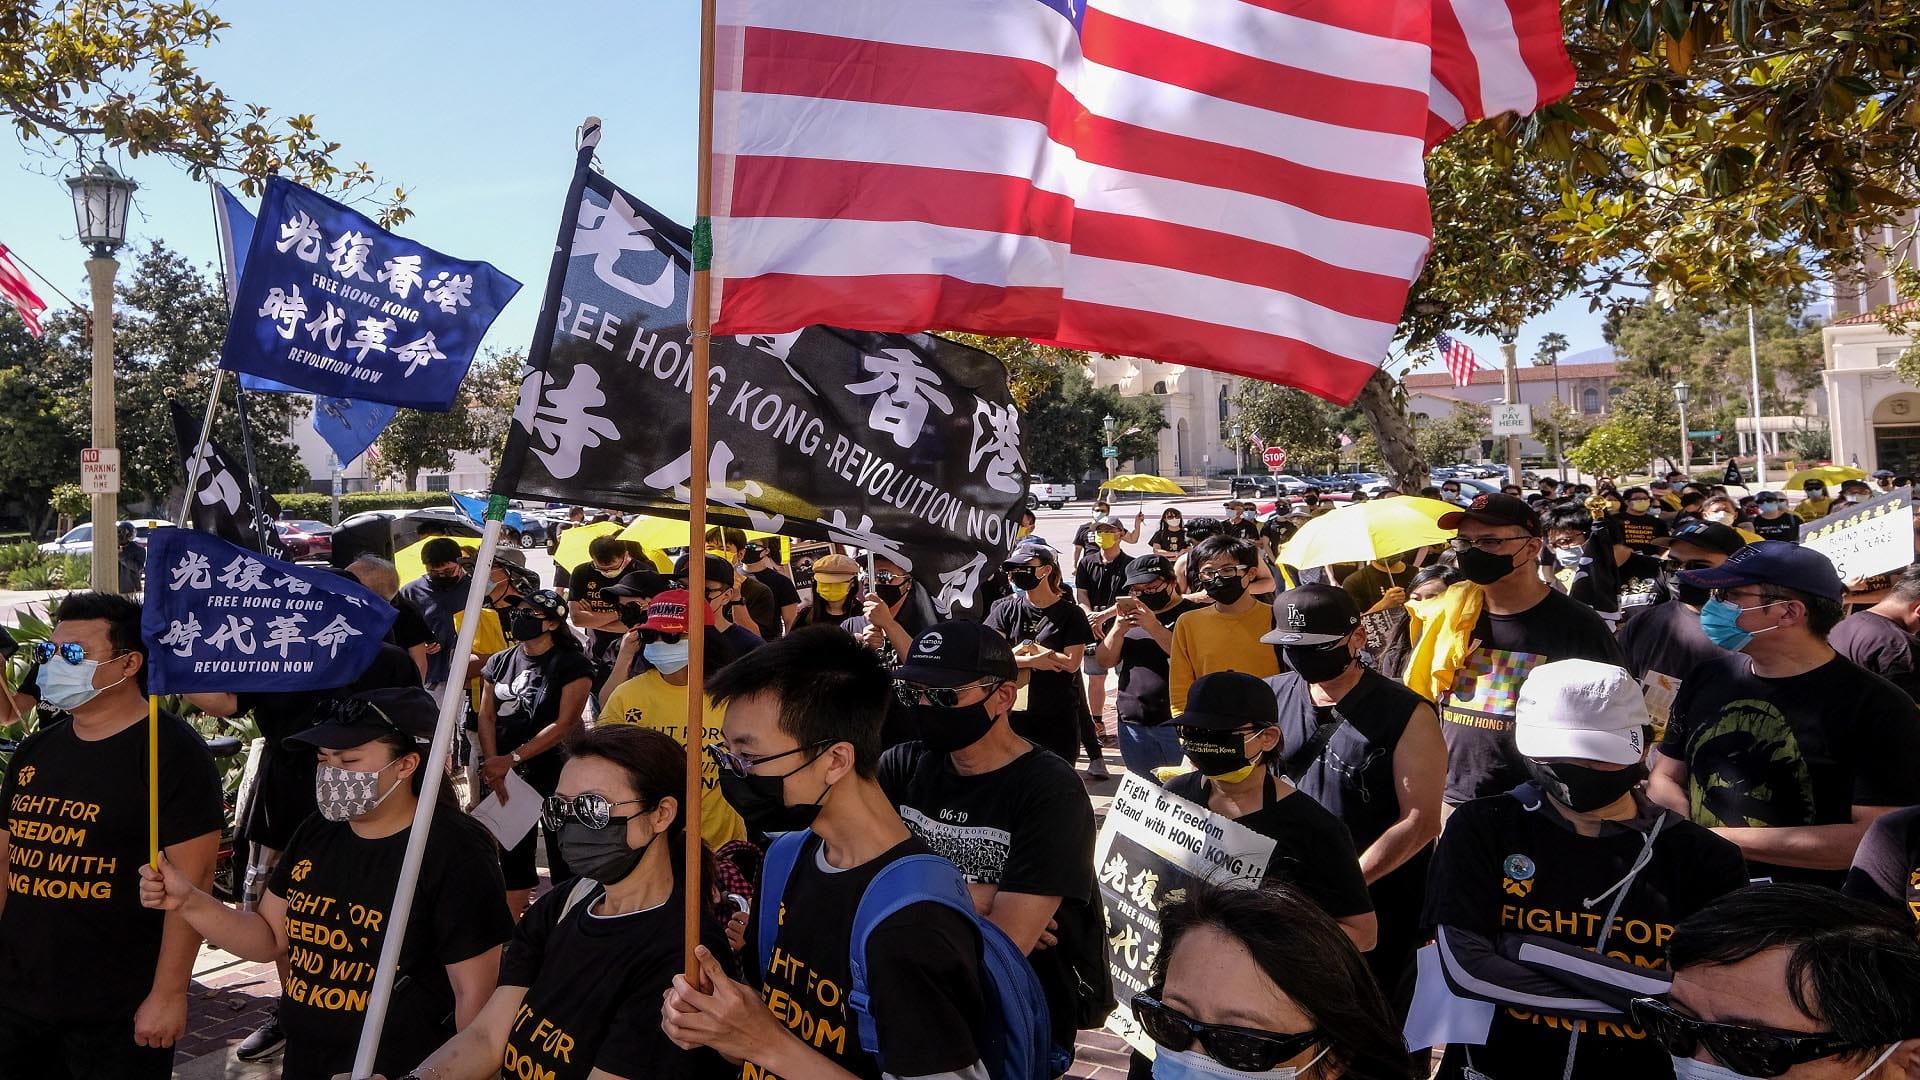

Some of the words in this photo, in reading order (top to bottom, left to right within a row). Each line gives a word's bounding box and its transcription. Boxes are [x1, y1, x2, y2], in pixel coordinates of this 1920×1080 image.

[276, 210, 473, 315] 光復香港
[312, 273, 338, 294] FREE
[340, 283, 380, 309] HONG
[381, 301, 420, 324] KONG
[258, 284, 448, 378] 時代革命
[541, 288, 622, 352] REE
[287, 347, 352, 376] REVOLUTION
[351, 365, 383, 384] NOW
[83, 451, 97, 461] NO
[84, 464, 116, 472] PARKING
[1264, 453, 1284, 462] STOP
[207, 595, 238, 608] FREE
[242, 596, 282, 609] HONG
[285, 598, 323, 611] KONG
[1288, 604, 1306, 627] LA
[158, 611, 363, 659] 時代革命
[194, 661, 279, 673] REVOLUTION
[283, 661, 314, 673] NOW
[1453, 712, 1474, 727] WITH
[1475, 716, 1504, 731] HONG
[59, 799, 101, 823] FOR
[1123, 779, 1150, 803] Fight
[1155, 795, 1169, 811] for
[1172, 804, 1225, 841] Freedom
[8, 818, 87, 848] REEDOM
[1115, 797, 1143, 822] Stand
[1144, 815, 1166, 836] with
[1168, 826, 1203, 855] HONG
[1205, 845, 1243, 875] KONG
[8, 843, 44, 869] TAND
[48, 852, 117, 875] WITH
[7, 871, 30, 895] NG
[33, 877, 112, 900] KONG
[335, 902, 383, 932] OR
[1117, 899, 1137, 921] FREE
[1137, 911, 1161, 935] HONG
[1501, 904, 1602, 937] FIGHT
[329, 958, 375, 983] WIT
[286, 968, 308, 1003] NG
[307, 984, 372, 1012] KON
[529, 1017, 576, 1064] FOR
